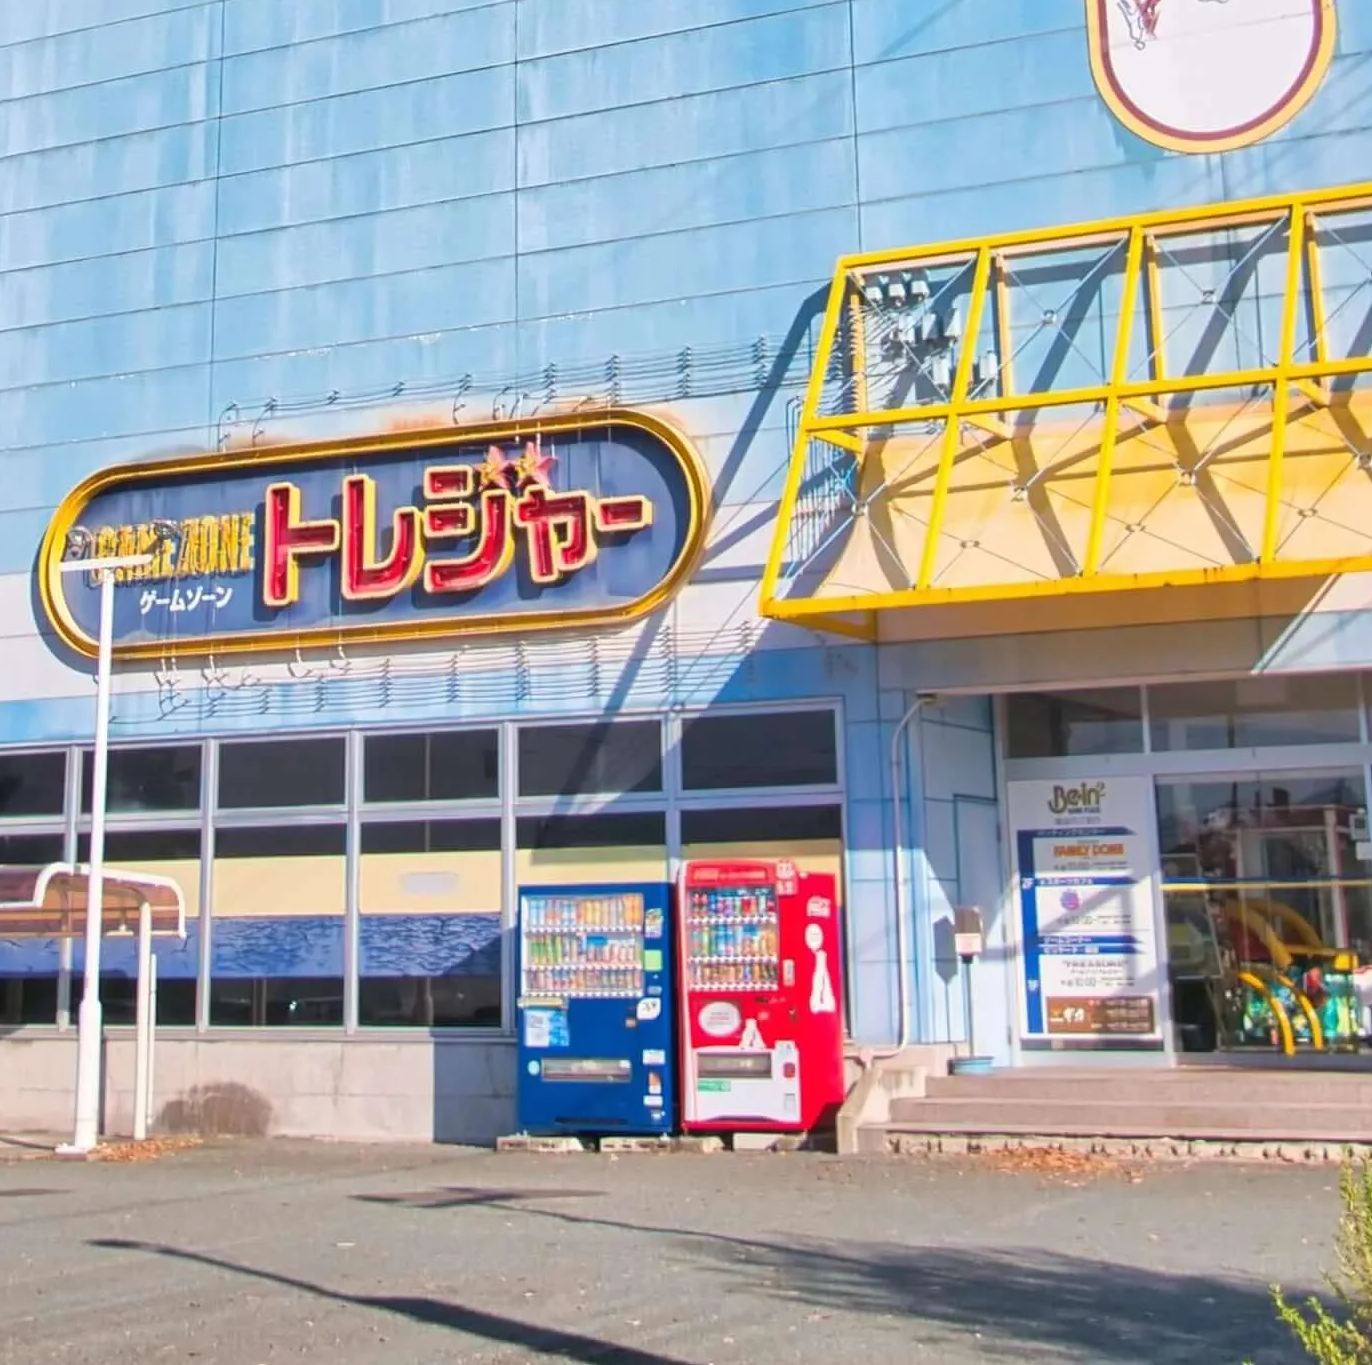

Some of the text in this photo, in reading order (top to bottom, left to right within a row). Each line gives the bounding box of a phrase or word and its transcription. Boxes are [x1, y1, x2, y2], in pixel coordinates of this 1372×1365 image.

[178, 511, 255, 576] ZONE
[264, 444, 653, 608] トレジャー
[140, 585, 233, 615] ゲームゾーン
